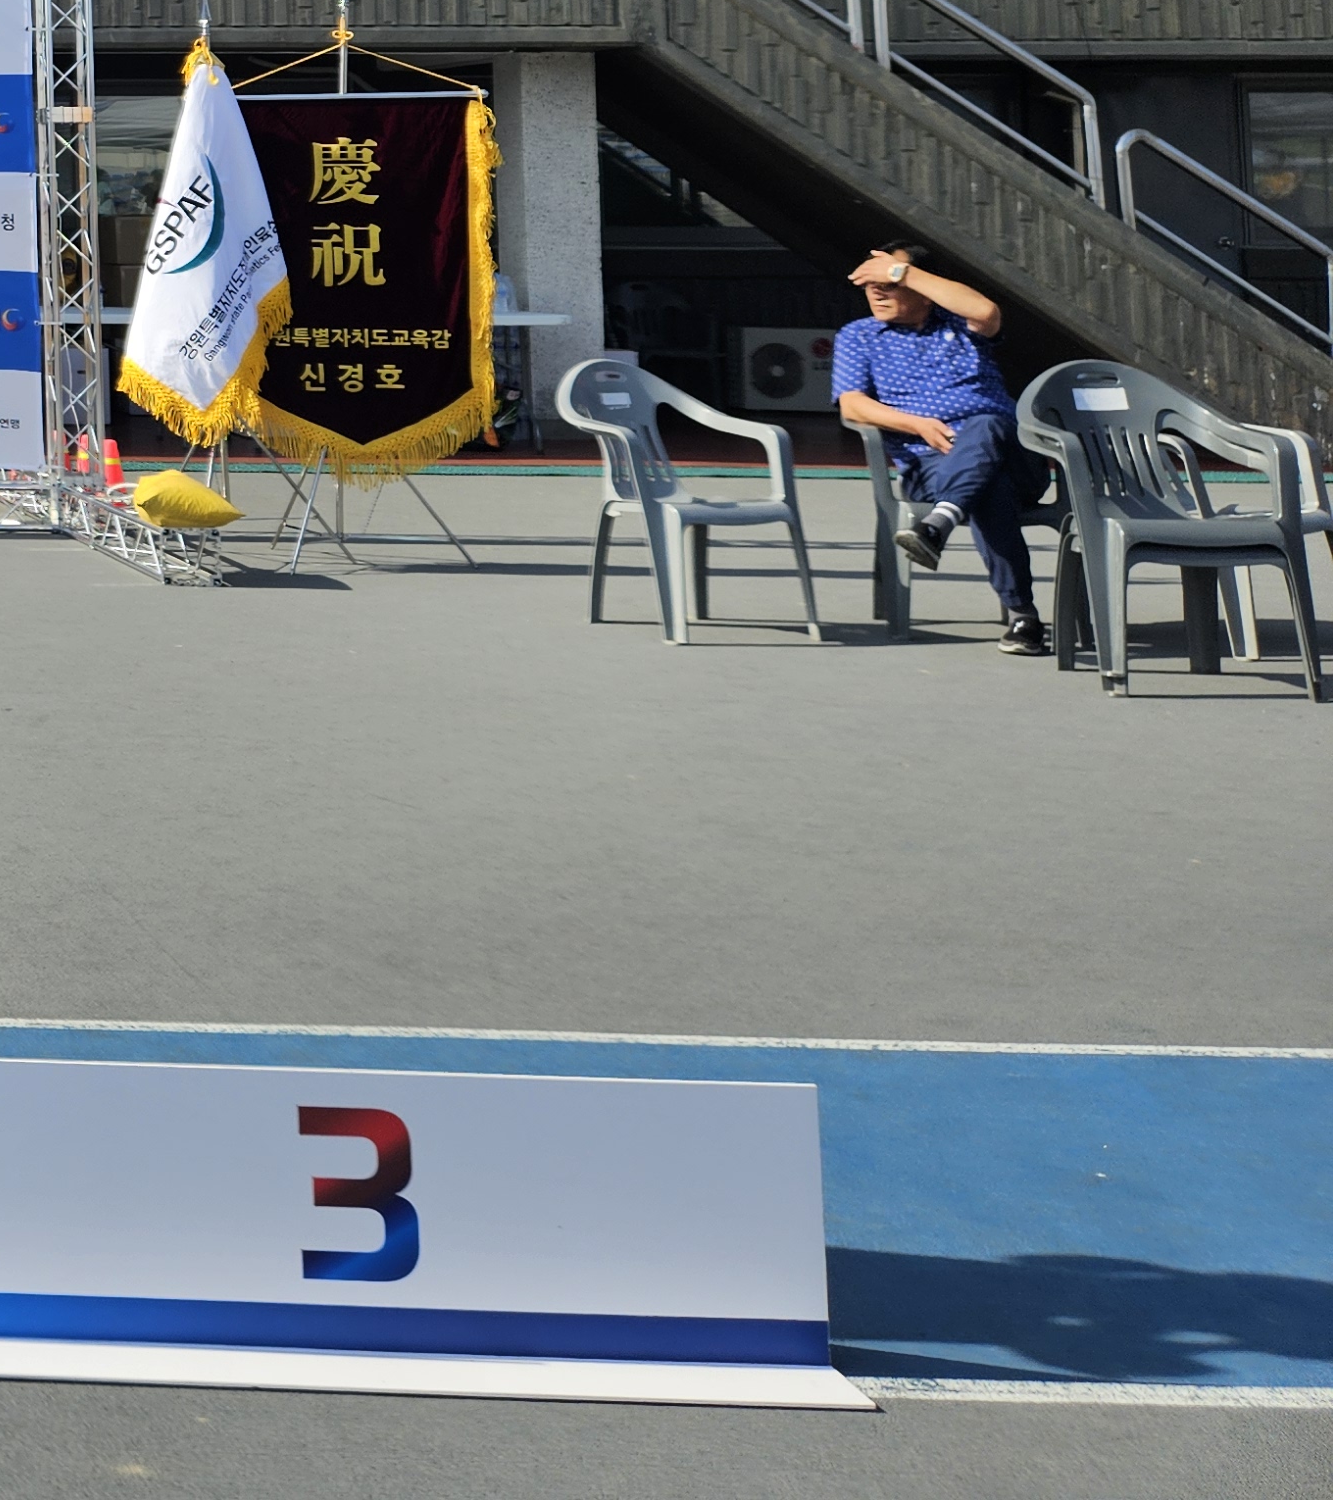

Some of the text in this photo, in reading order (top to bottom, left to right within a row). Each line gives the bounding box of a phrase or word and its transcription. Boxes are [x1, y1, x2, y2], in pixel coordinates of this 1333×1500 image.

[145, 175, 213, 275] GSPAF
[274, 327, 452, 350] 원특별자치도교육감
[299, 1106, 421, 1283] 3
